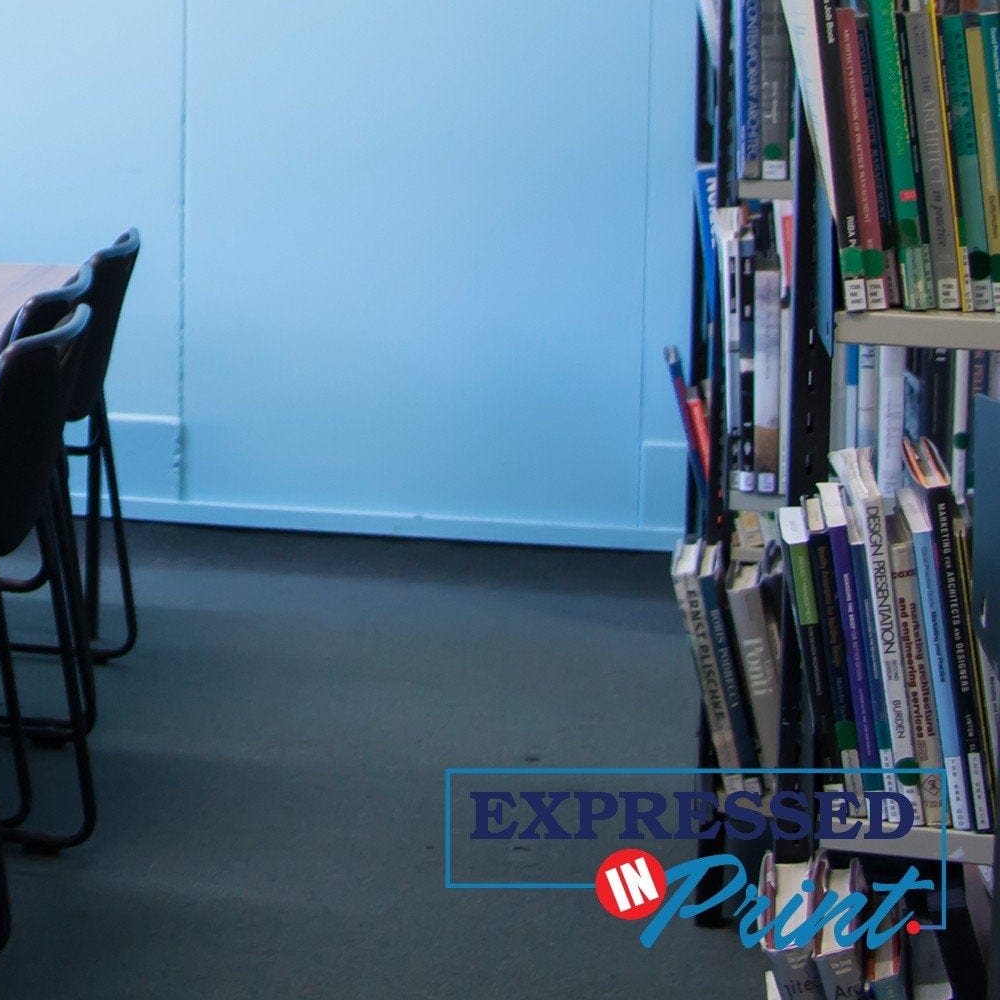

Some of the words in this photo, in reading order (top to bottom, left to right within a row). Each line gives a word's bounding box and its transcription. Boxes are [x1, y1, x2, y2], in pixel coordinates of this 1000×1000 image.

[823, 4, 833, 21] Job
[825, 21, 836, 44] Book
[921, 75, 931, 92] THE
[854, 133, 865, 170] PRACTICE
[922, 97, 943, 187] ARCHITECT
[859, 171, 871, 223] MANAGEMENT
[932, 190, 941, 202] in
[846, 215, 856, 237] RIBA
[930, 205, 950, 248] practice
[866, 505, 884, 556] DESIGN
[937, 502, 952, 554] MARKETING
[944, 556, 952, 569] FOR
[873, 560, 897, 655] PRESENTATION
[899, 597, 909, 618] and
[946, 571, 962, 625] ARCHITECTS
[710, 609, 723, 643] BORIS
[931, 611, 942, 641] Marketing
[953, 627, 962, 641] AND
[687, 590, 704, 639] ERNST
[700, 644, 725, 723] PLISCHKE
[743, 637, 773, 696] Ponti
[900, 622, 918, 688] engineering
[909, 602, 927, 660] marketing
[918, 663, 936, 737] architectural
[934, 643, 943, 657] your
[936, 657, 946, 683] Practice
[956, 643, 970, 692] DESIGNERS
[892, 700, 907, 740] BURDEN
[911, 691, 925, 738] services
